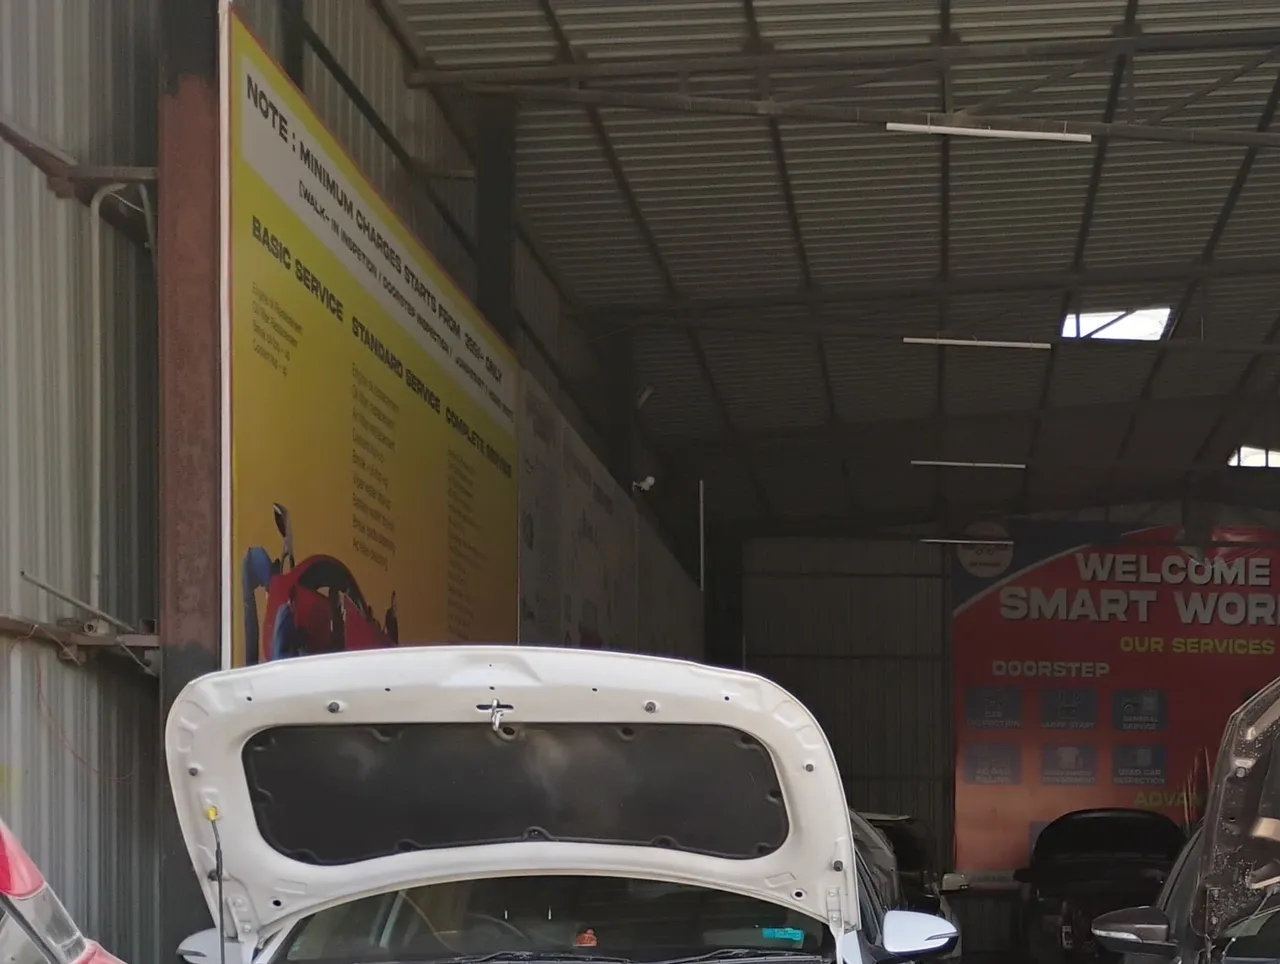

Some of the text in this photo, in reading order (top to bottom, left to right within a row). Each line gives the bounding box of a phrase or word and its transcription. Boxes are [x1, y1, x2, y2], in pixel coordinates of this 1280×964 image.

[247, 74, 288, 143] NOTE
[299, 141, 354, 220] MINIMUM
[356, 209, 402, 275] CHARGES
[404, 264, 437, 313] STARTS
[438, 303, 461, 340] FROM
[252, 214, 344, 323] BASIC SERVICE
[352, 316, 403, 379] STANDARD
[405, 368, 440, 415] SERVICE
[446, 406, 485, 455] COMPLETE
[1075, 553, 1271, 587] WELCOME
[999, 586, 1157, 623] SMART
[1120, 636, 1275, 656] OUR SERVICES
[992, 660, 1110, 678] DOORSTEP
